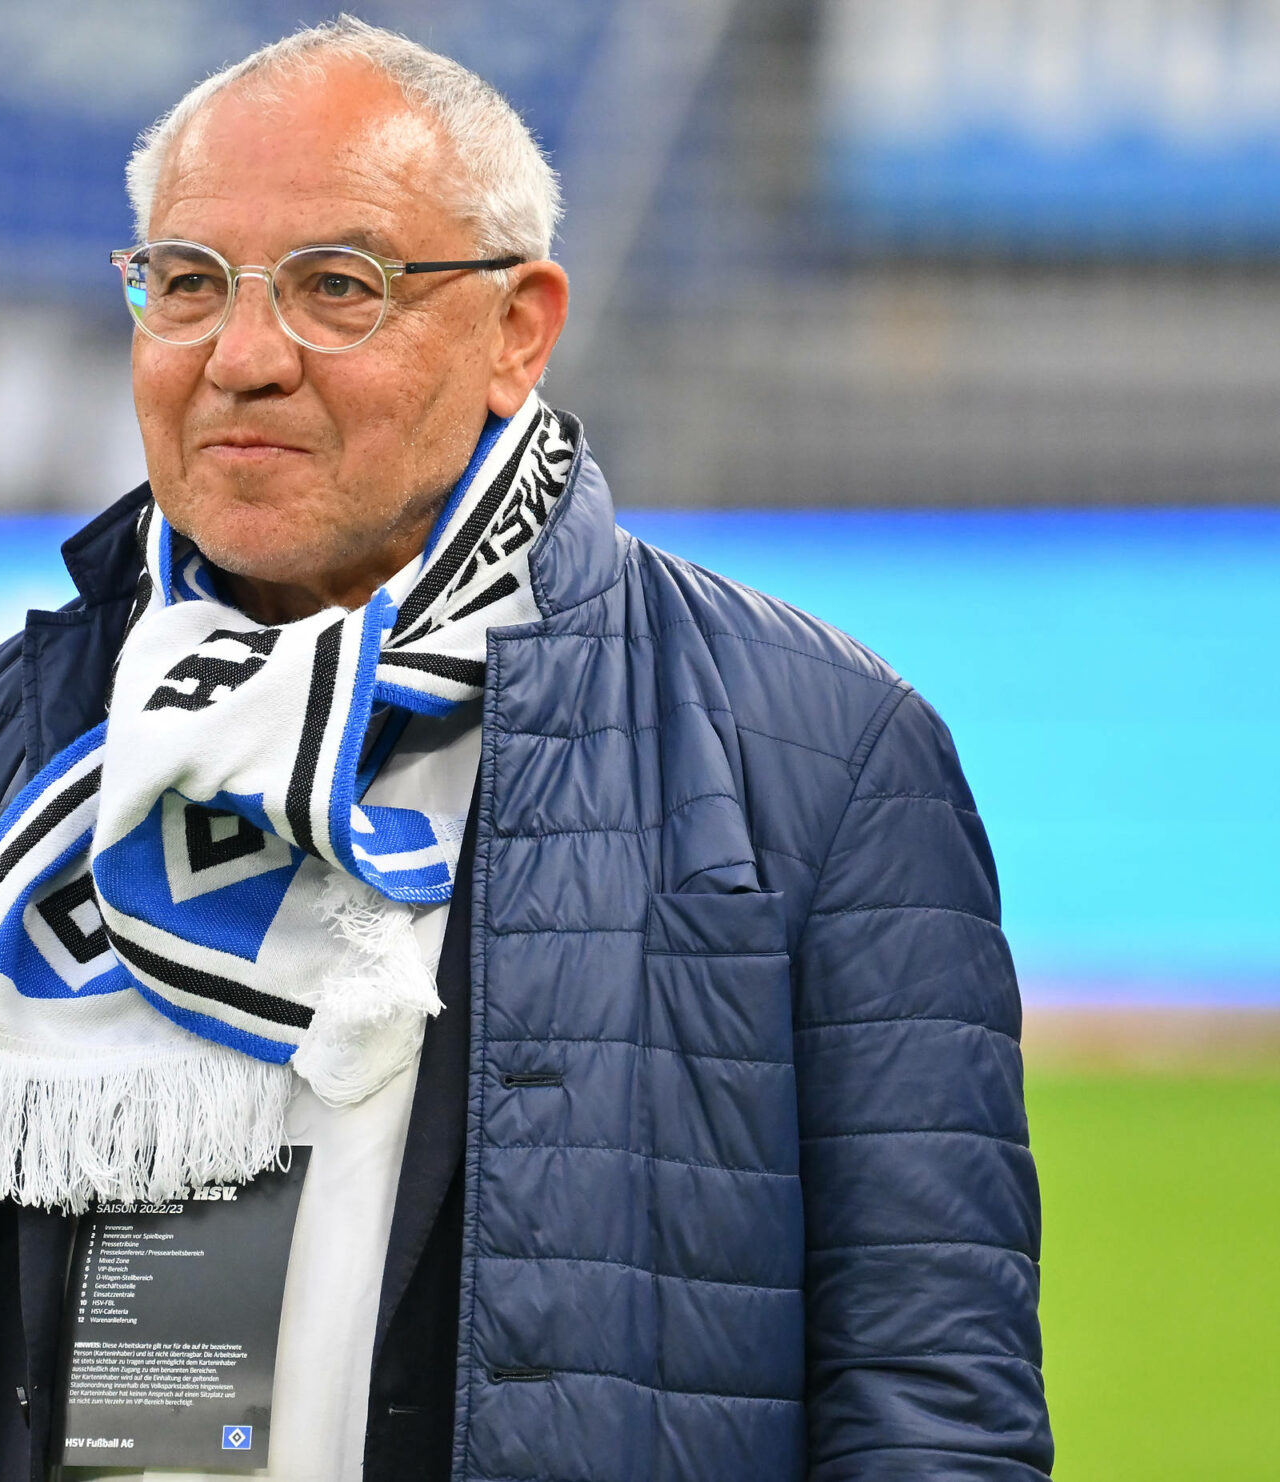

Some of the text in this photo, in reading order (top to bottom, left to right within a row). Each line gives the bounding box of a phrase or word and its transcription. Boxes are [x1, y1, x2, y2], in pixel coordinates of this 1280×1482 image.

[192, 1186, 237, 1200] HSV.
[96, 1204, 184, 1214] SAISON 2022/23
[65, 1438, 134, 1448] HSV Fußball AG
